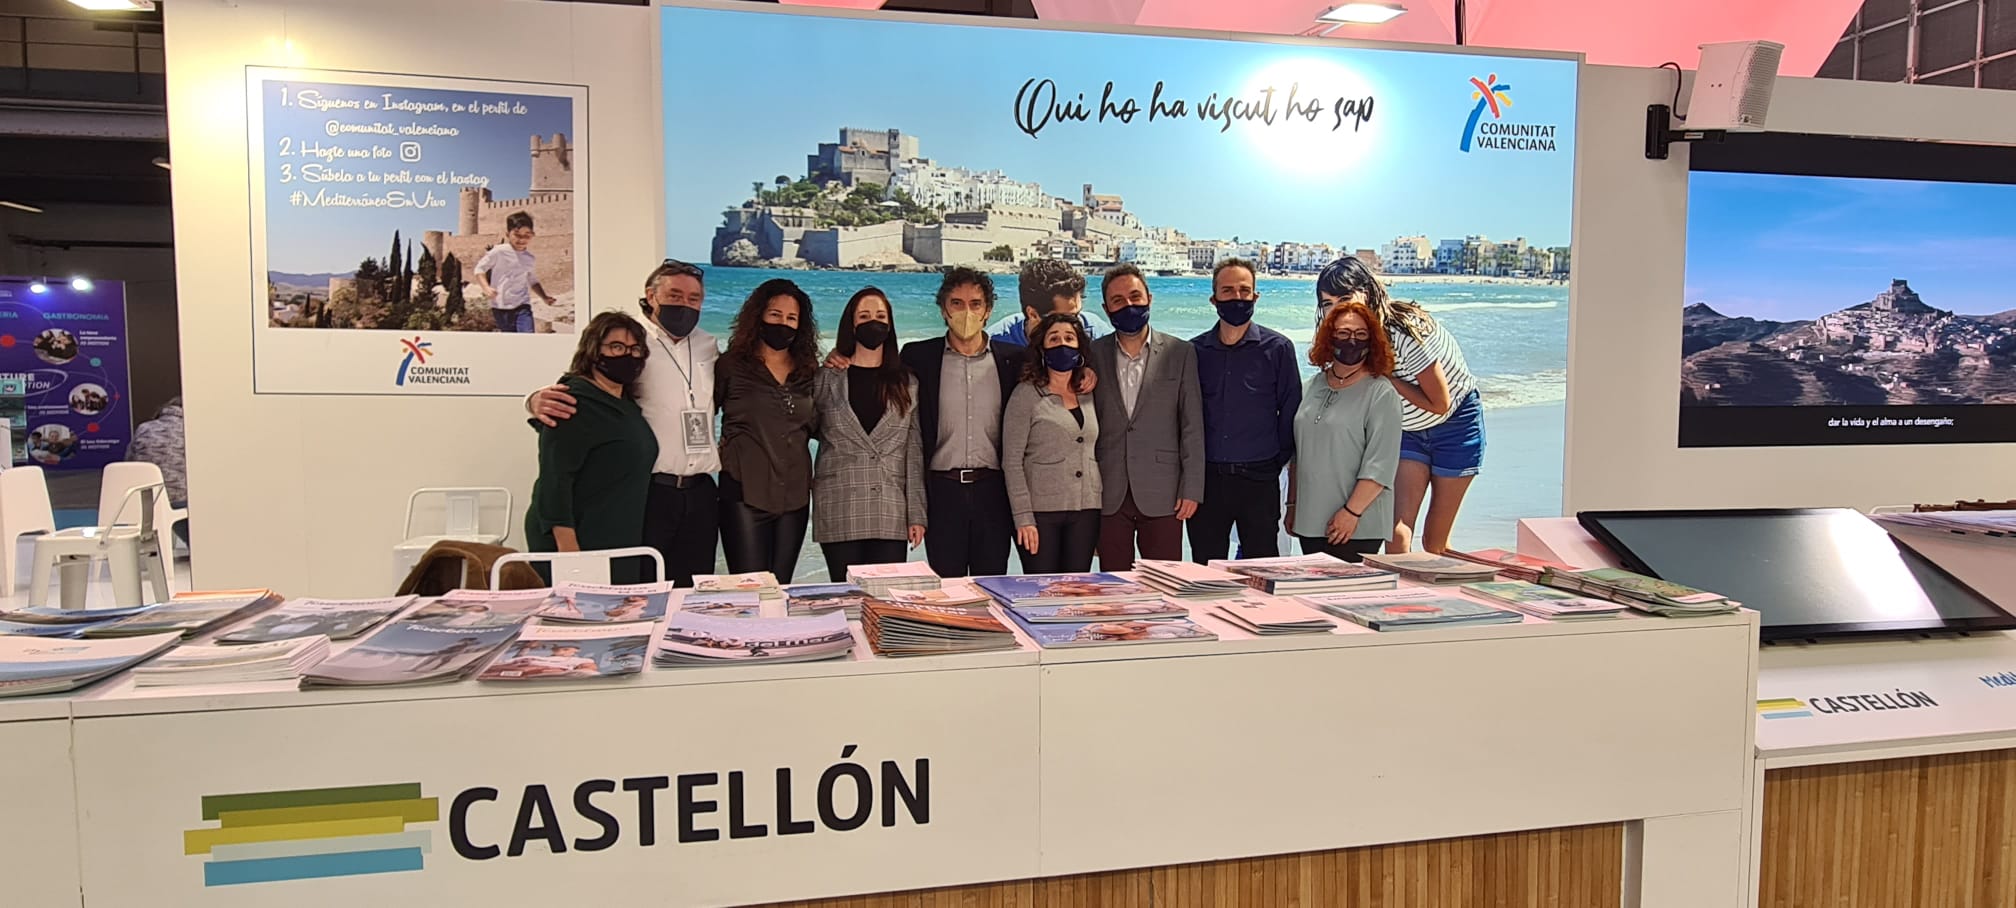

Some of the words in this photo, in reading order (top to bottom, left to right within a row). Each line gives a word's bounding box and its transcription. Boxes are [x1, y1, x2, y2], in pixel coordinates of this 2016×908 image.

[281, 86, 293, 106] 1.
[363, 100, 378, 109] en
[382, 93, 449, 114] Instagram,
[452, 103, 465, 112] en
[468, 101, 479, 113] el
[482, 101, 510, 115] perfil
[512, 101, 528, 114] de
[1014, 78, 1091, 139] Qui
[1099, 81, 1140, 124] ho
[1149, 81, 1188, 122] ha
[1197, 85, 1278, 133] viscut
[1286, 82, 1324, 121] ho
[1332, 96, 1374, 132] sap
[325, 119, 459, 136] @comunitat_valenciana
[1480, 122, 1556, 137] COMUNITAT
[280, 136, 295, 156] 2.
[301, 141, 344, 162] Hazte
[347, 149, 370, 158] una
[373, 145, 392, 159] foto
[1477, 136, 1556, 151] VALENCIANA
[280, 163, 297, 183] 3.
[301, 163, 353, 182] Súbela
[356, 173, 365, 182] a
[368, 171, 381, 182] tu
[384, 170, 412, 184] perfil
[415, 175, 433, 183] con
[436, 171, 448, 183] el
[450, 171, 490, 187] hastag
[289, 187, 446, 208] #MediterráneoEnVivo
[408, 375, 470, 384] VALENCIANA
[410, 366, 469, 375] COMUNITAT
[1828, 418, 1840, 427] dar
[1842, 417, 1848, 426] la
[1850, 418, 1864, 426] vida
[1866, 420, 1871, 428] y
[1872, 417, 1879, 426] el
[1880, 417, 1897, 426] alma
[1809, 688, 1939, 714] CASTELLÓN
[449, 745, 929, 861] CASTELLÓN
